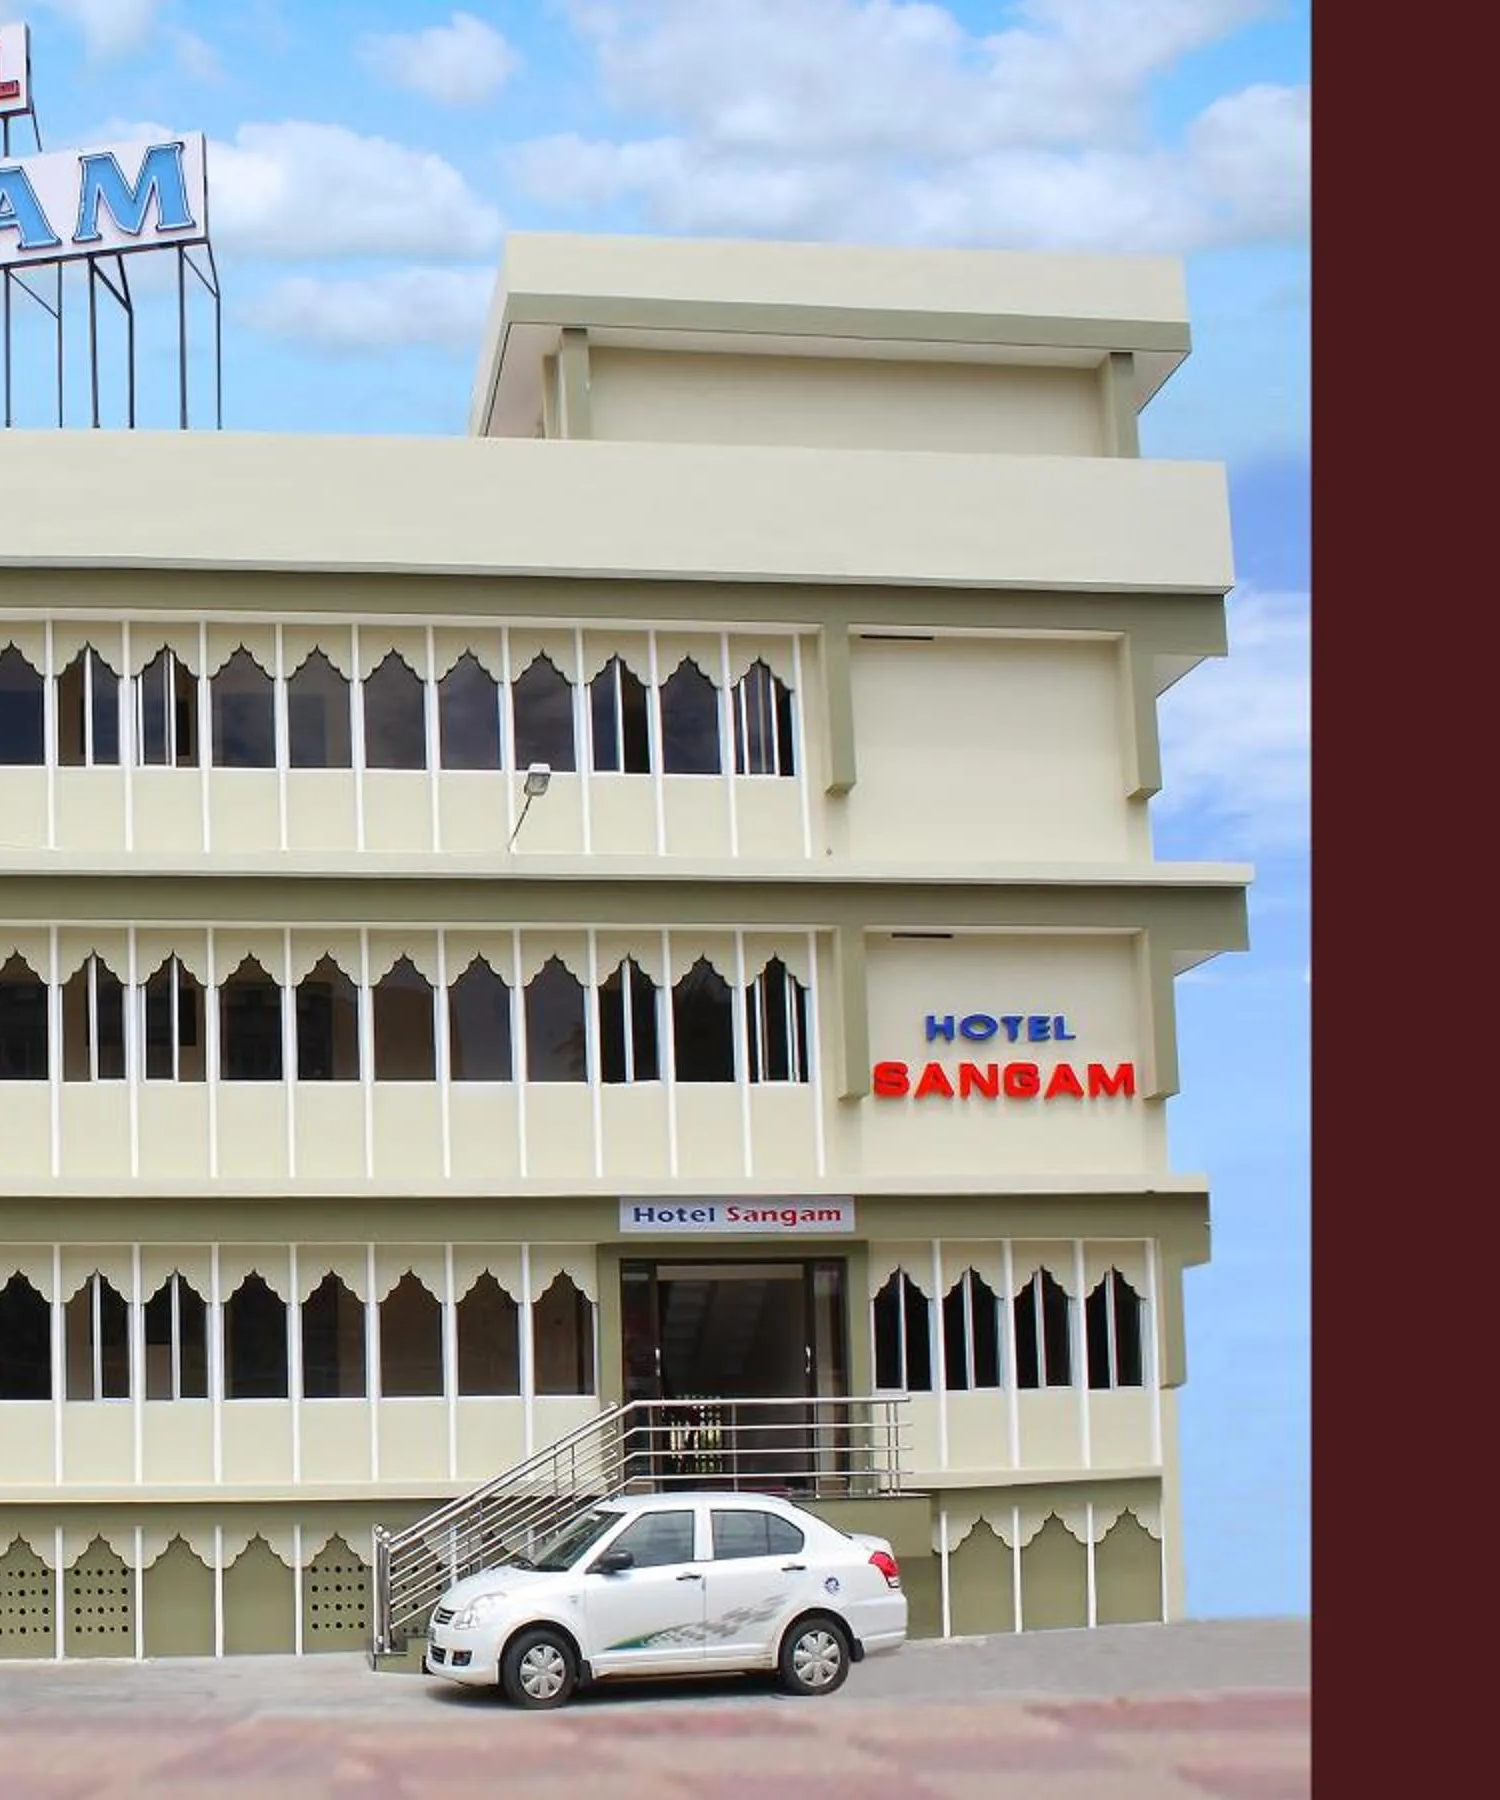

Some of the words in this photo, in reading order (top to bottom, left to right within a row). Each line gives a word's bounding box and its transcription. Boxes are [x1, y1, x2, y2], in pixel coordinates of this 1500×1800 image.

[924, 1014, 1076, 1042] HOTEL
[873, 1061, 1135, 1098] SANGAM
[633, 1206, 715, 1223] Hotel
[726, 1206, 841, 1226] Sangam
